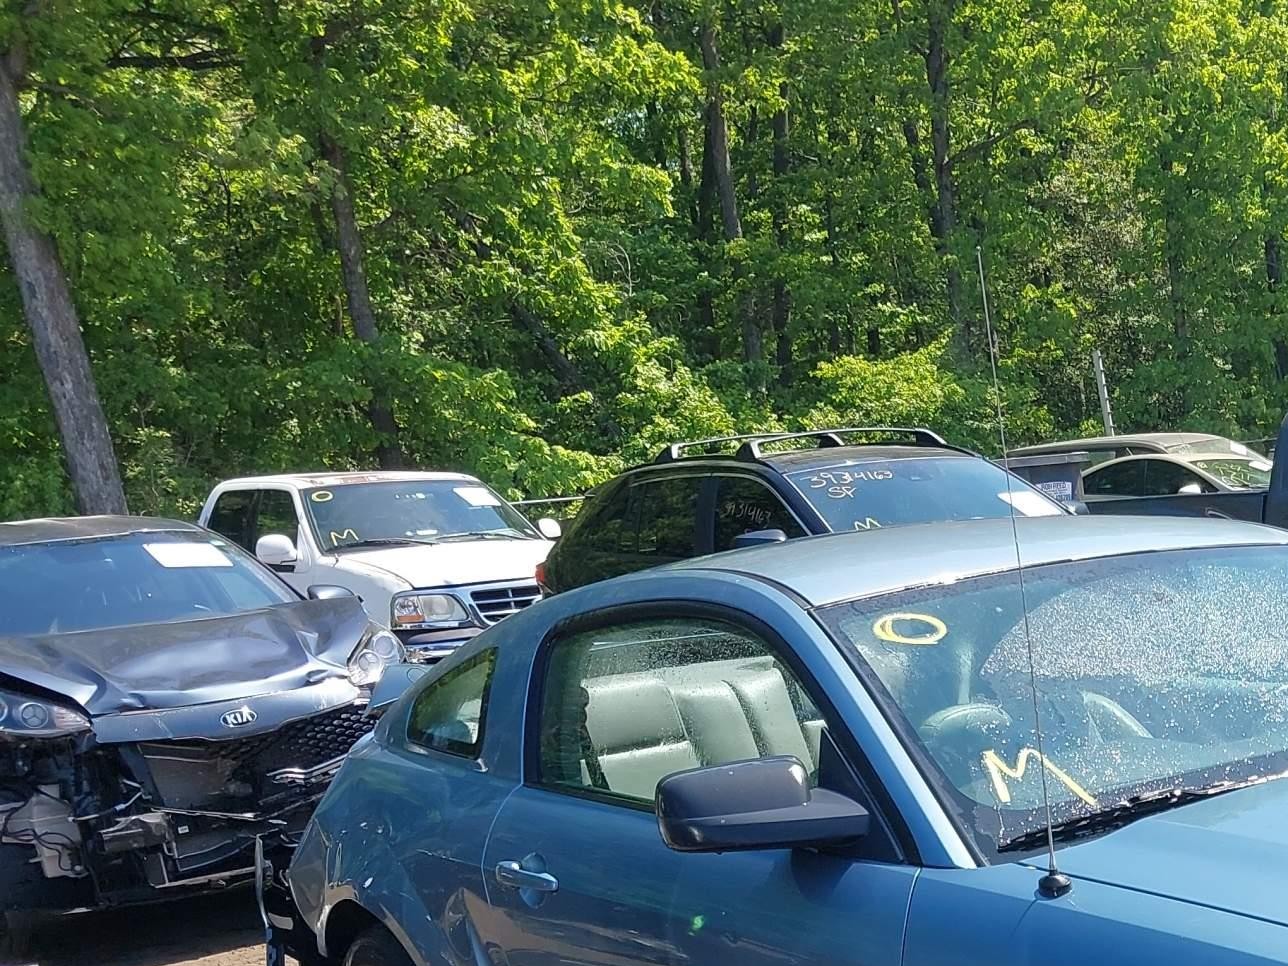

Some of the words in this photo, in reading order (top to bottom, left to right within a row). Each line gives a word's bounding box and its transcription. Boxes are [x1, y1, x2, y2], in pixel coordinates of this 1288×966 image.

[330, 528, 360, 546] M
[225, 710, 253, 725] KIA
[982, 747, 1098, 808] M
